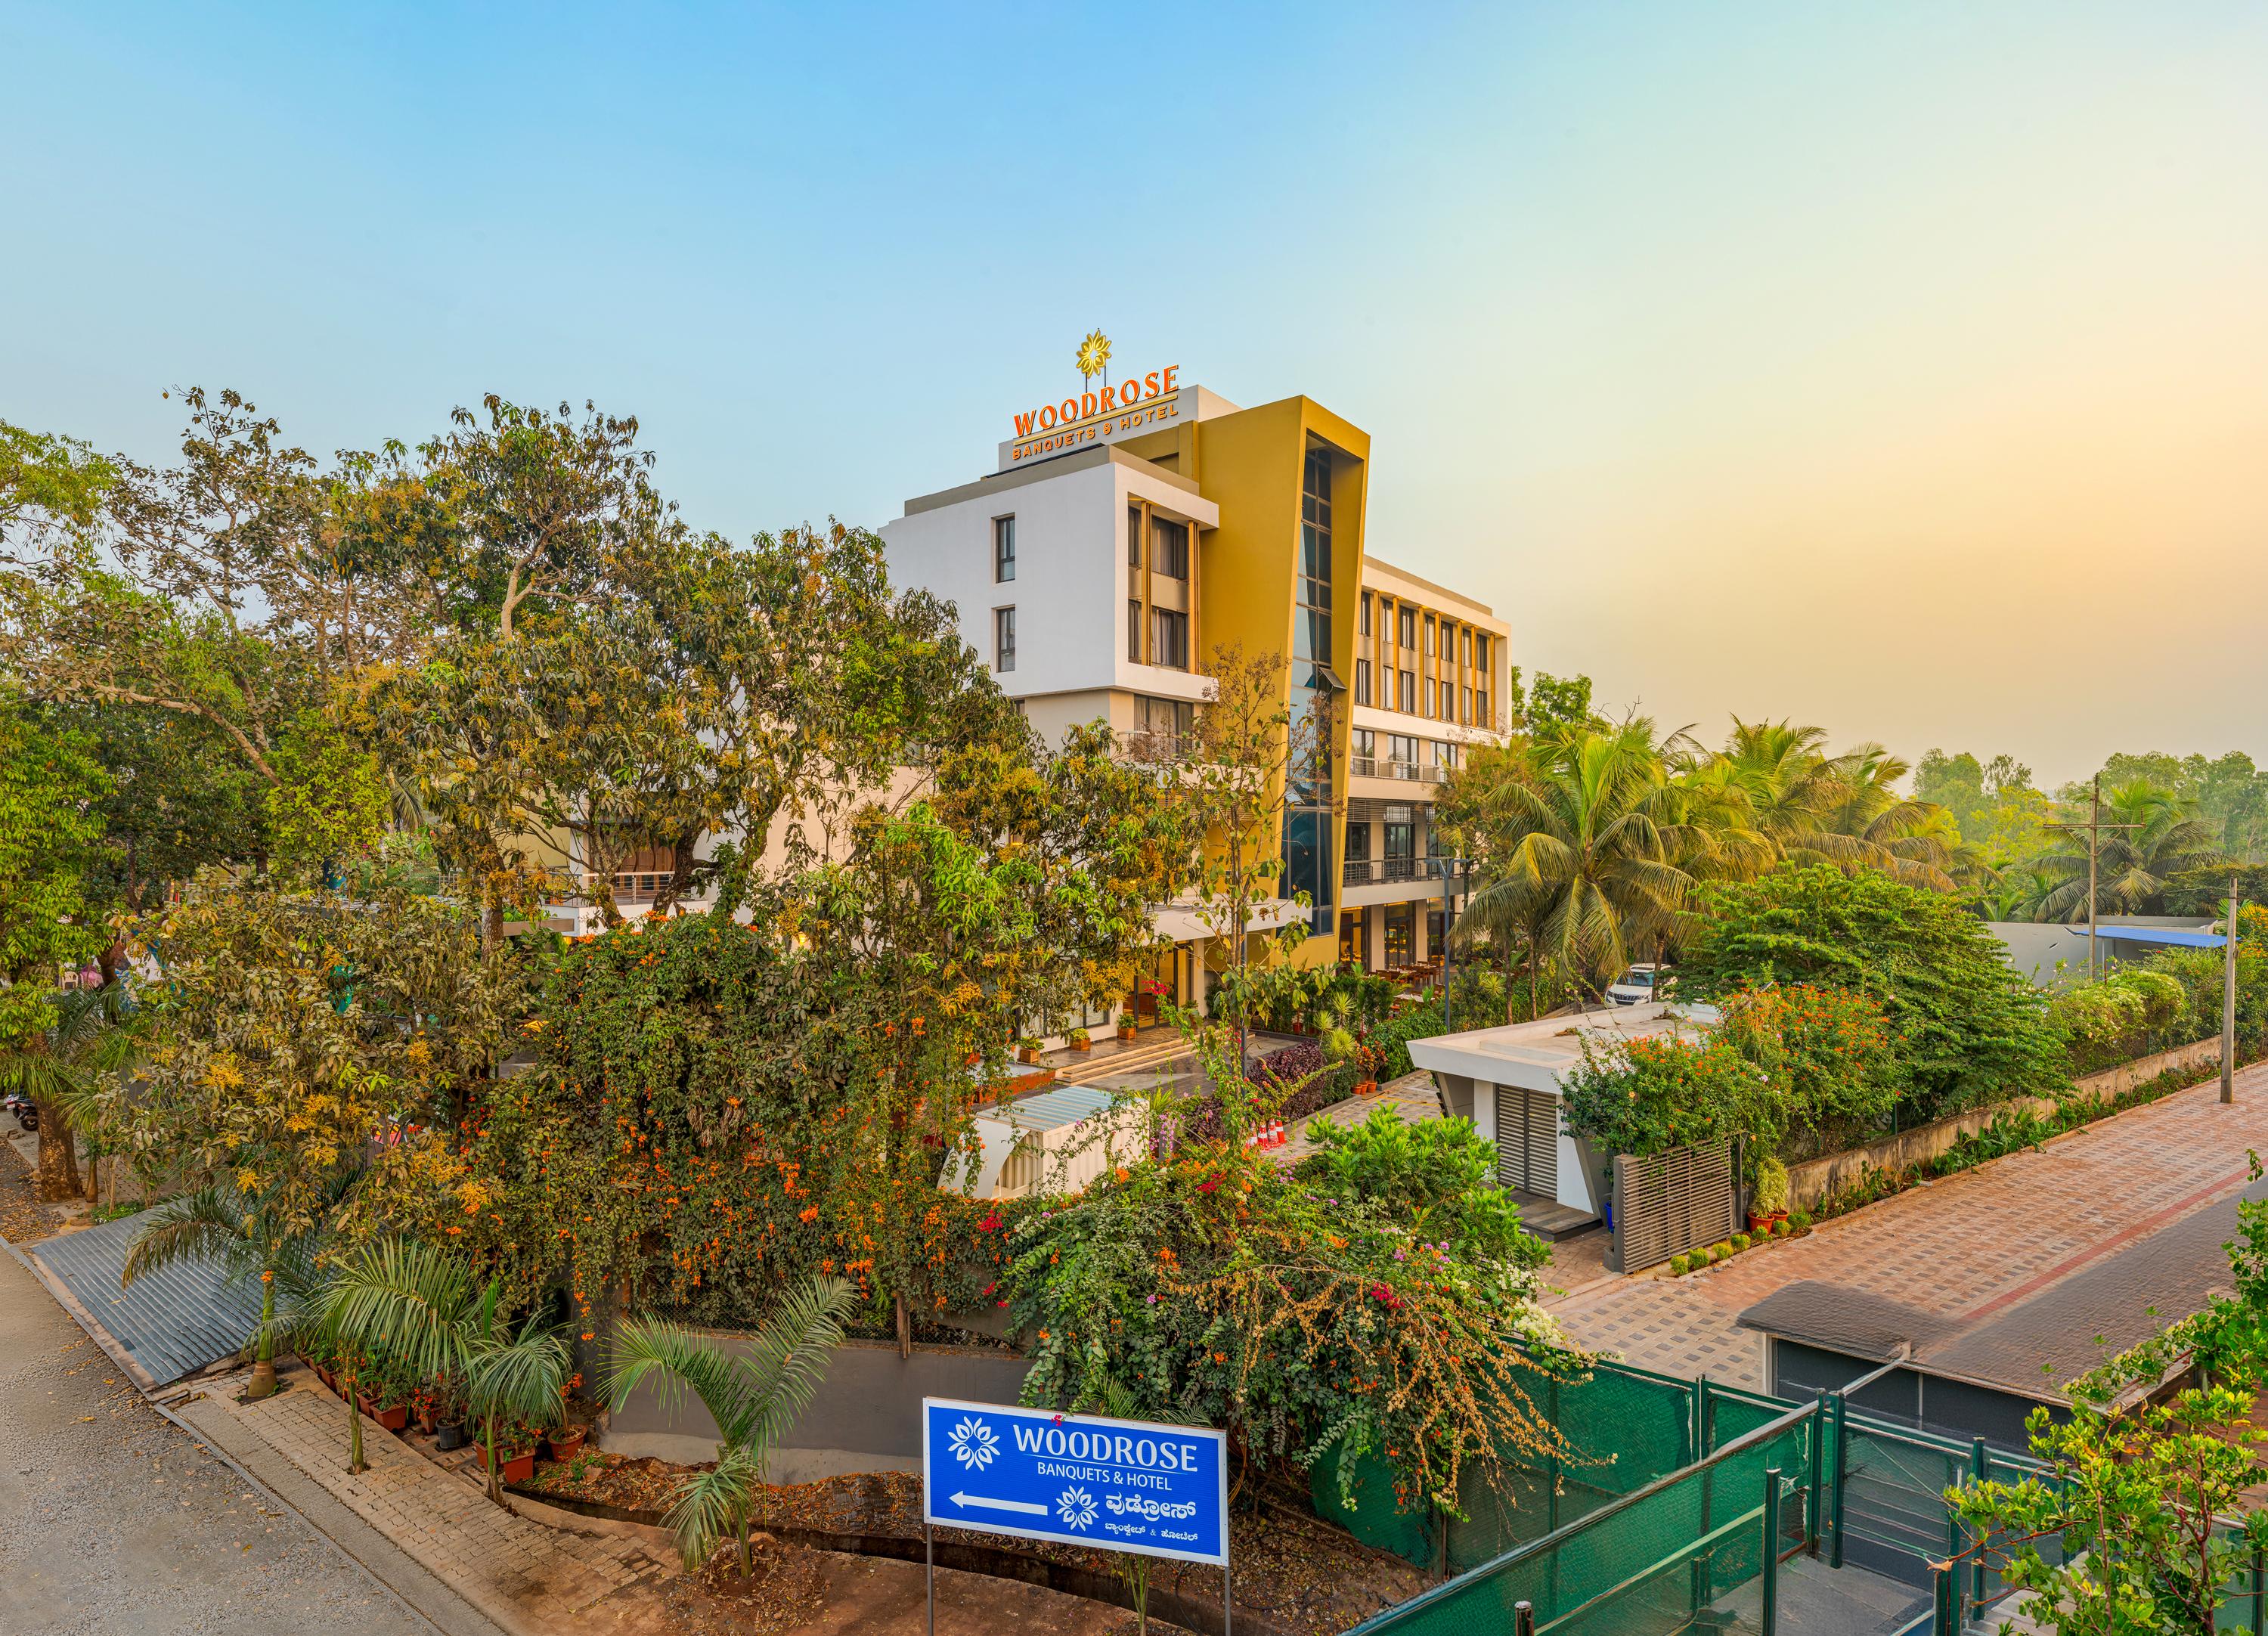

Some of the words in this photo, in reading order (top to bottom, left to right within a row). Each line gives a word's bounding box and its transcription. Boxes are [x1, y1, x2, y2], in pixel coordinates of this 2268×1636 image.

[1013, 364, 1179, 438] WOODROSE
[1012, 427, 1095, 460] BANQUETS
[1103, 423, 1112, 435] &
[1120, 404, 1179, 430] HOTEL
[1013, 1424, 1198, 1472] WOODROSE
[1037, 1461, 1110, 1483] BANQUETS
[1114, 1471, 1123, 1485] &
[1126, 1473, 1173, 1491] HOTEL
